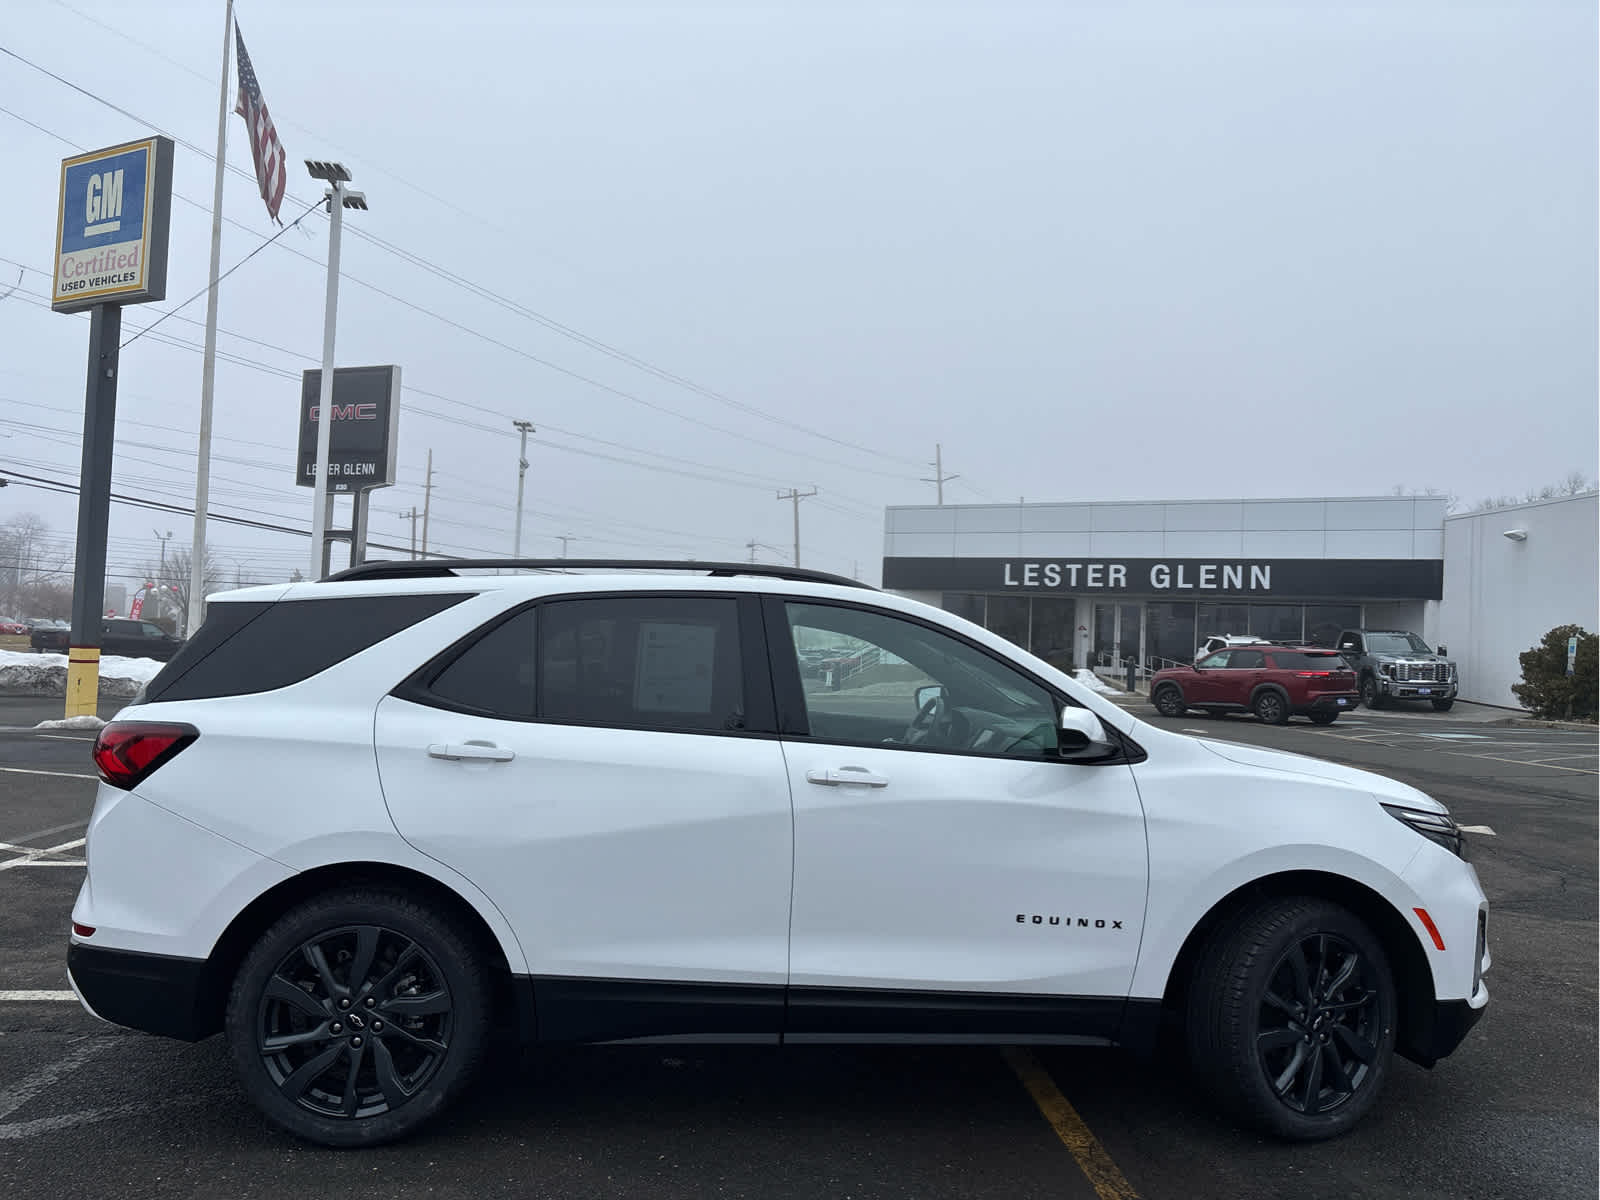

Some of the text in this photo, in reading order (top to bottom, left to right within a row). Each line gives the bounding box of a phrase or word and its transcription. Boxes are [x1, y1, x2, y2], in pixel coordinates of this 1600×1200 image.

[86, 169, 124, 224] GM
[62, 244, 139, 279] Certified
[61, 271, 136, 292] USED VEHICLES
[306, 463, 376, 476] LEER GLENN
[1004, 563, 1271, 590] LESTER GLENN
[1016, 914, 1123, 930] EQUINOX
